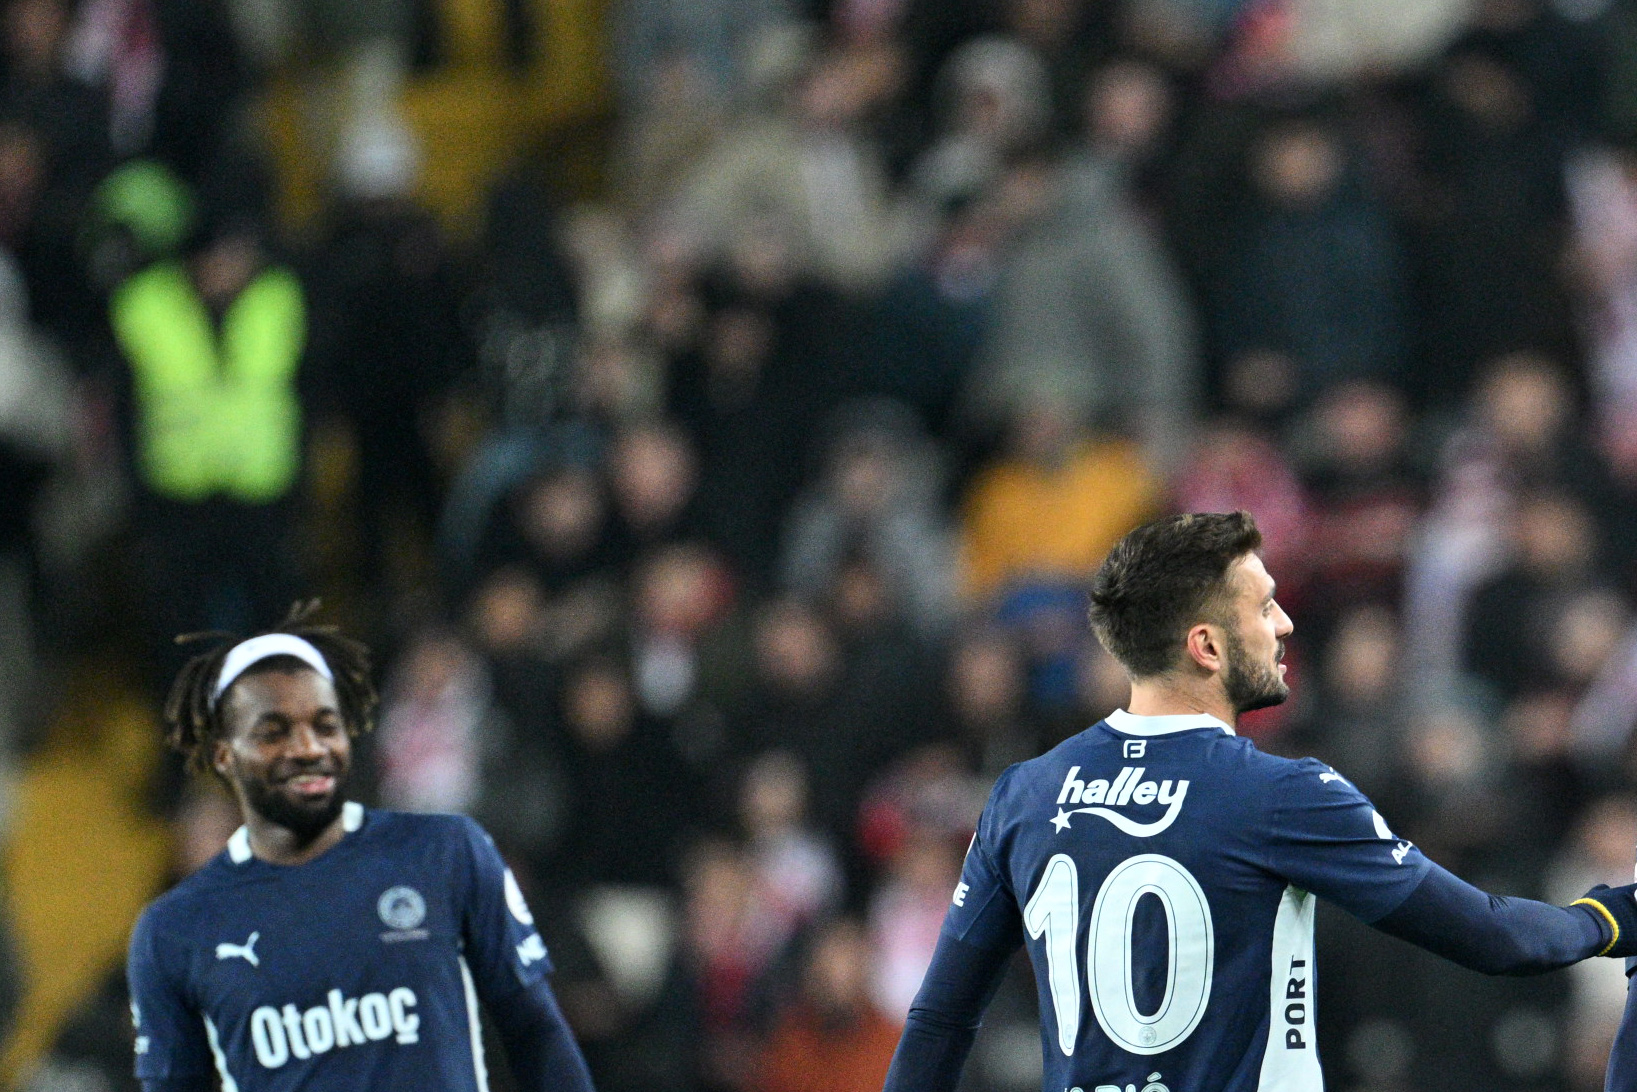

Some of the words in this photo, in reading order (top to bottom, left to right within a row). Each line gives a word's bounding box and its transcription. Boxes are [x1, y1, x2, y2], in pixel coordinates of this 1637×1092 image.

[1056, 766, 1190, 838] halley
[1023, 853, 1215, 1057] 10
[250, 986, 420, 1069] Otokoç
[1284, 955, 1307, 1050] PORT
